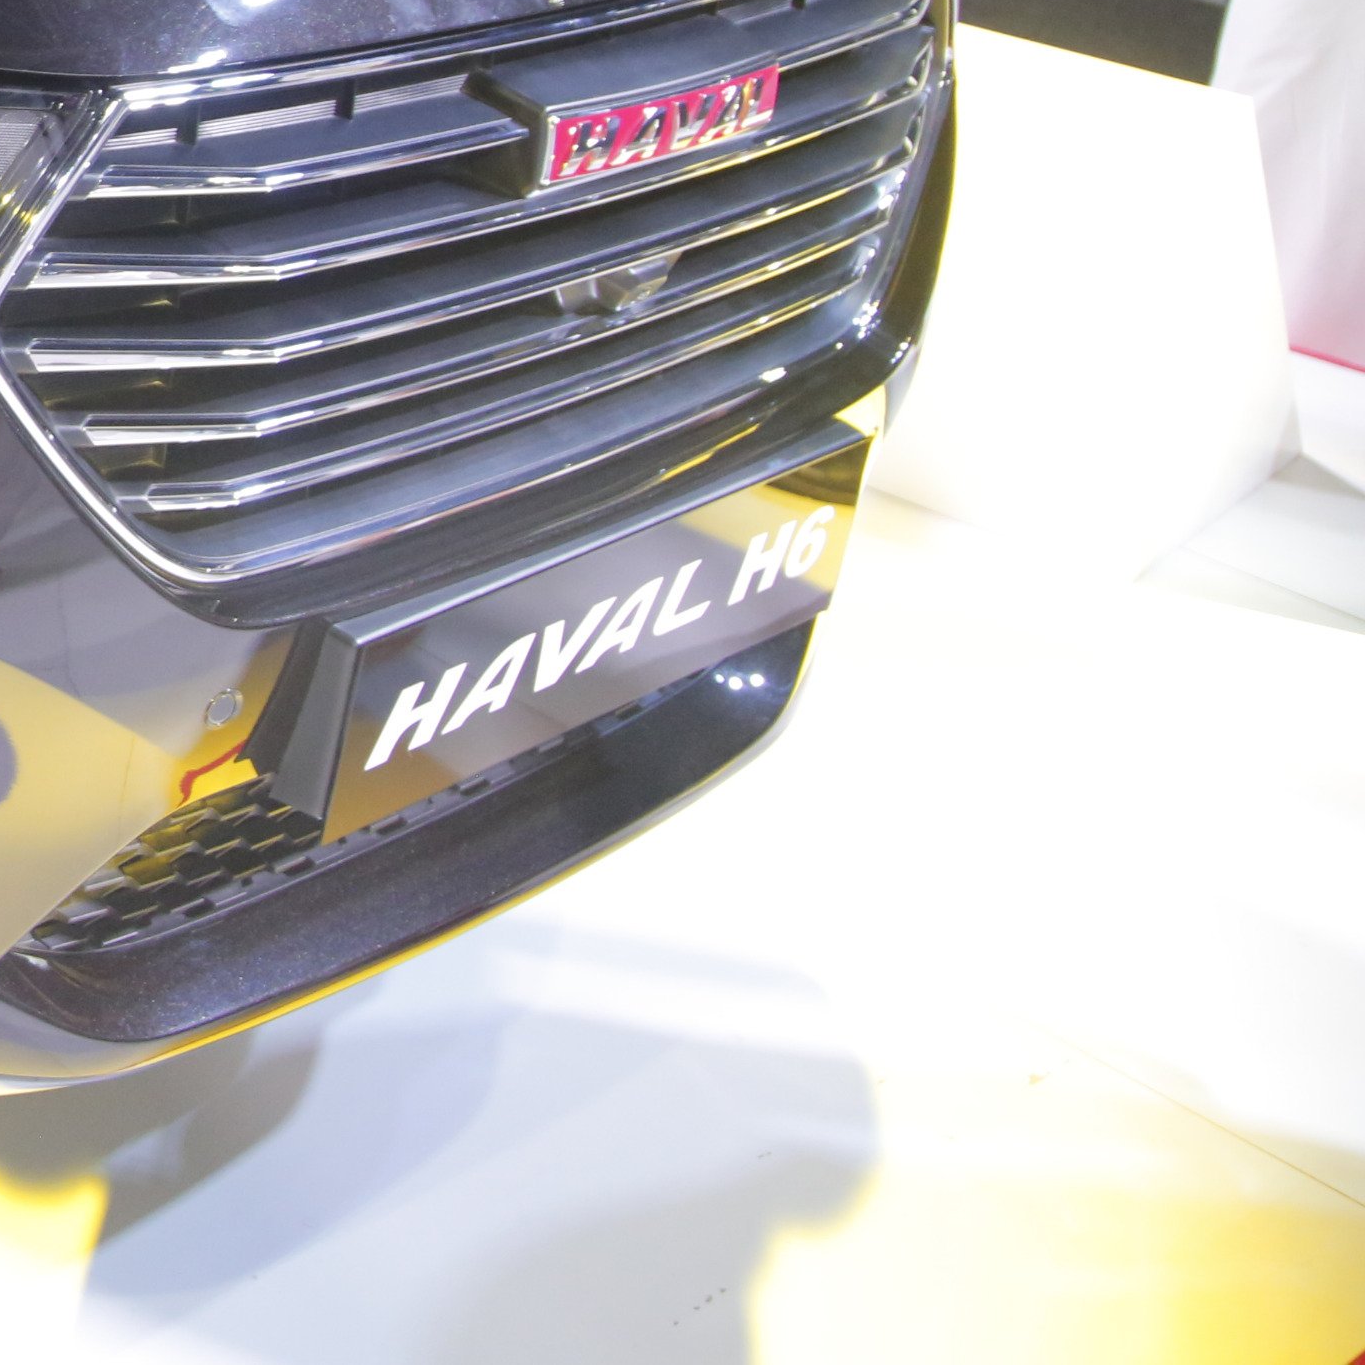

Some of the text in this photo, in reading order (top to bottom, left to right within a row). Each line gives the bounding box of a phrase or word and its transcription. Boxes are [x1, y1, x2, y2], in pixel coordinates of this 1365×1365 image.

[559, 75, 774, 178] HAVAL
[363, 503, 835, 774] HAVAL H6
